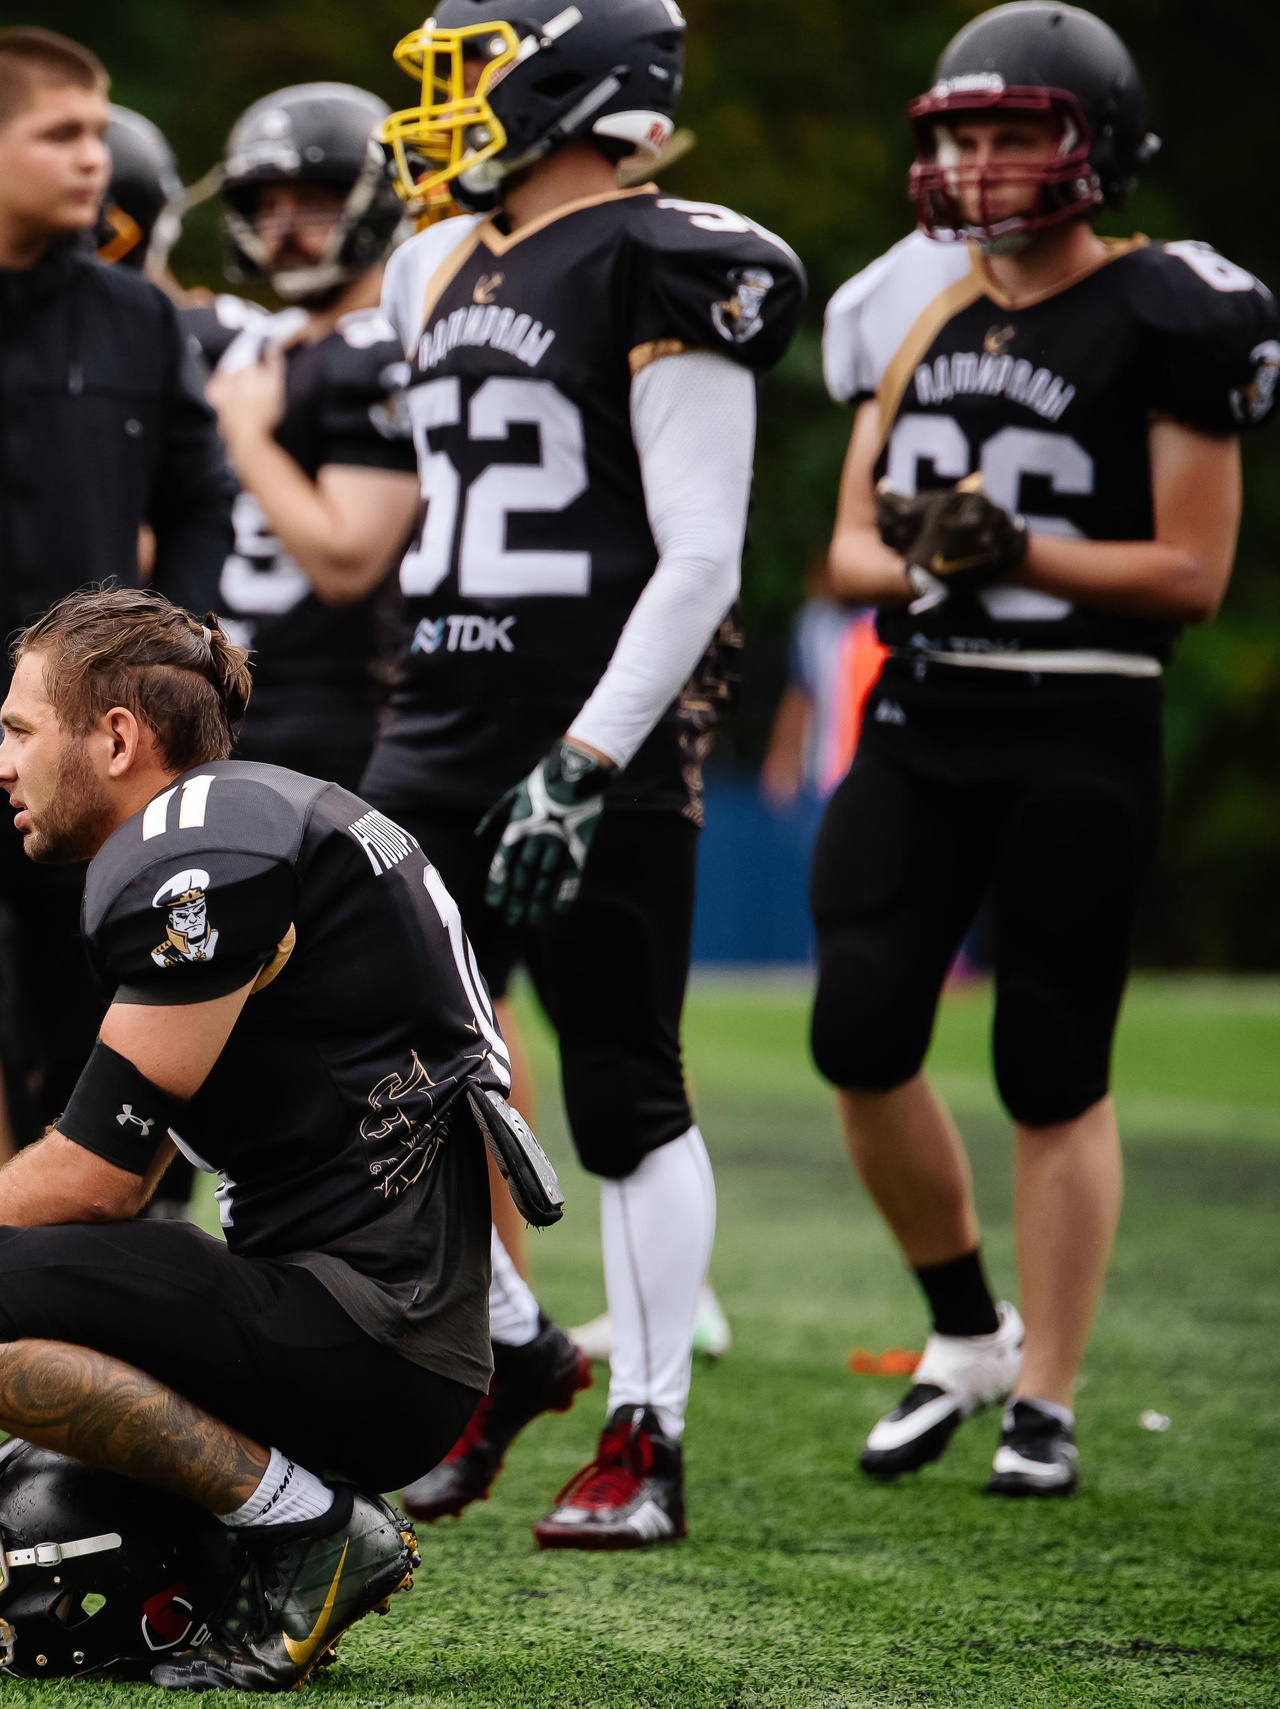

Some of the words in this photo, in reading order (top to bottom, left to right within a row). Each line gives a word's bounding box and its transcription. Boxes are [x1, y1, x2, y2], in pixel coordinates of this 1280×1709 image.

[400, 377, 590, 596] 52
[446, 614, 517, 652] TDK
[142, 774, 217, 842] 11
[259, 1460, 295, 1515] DEMIX
